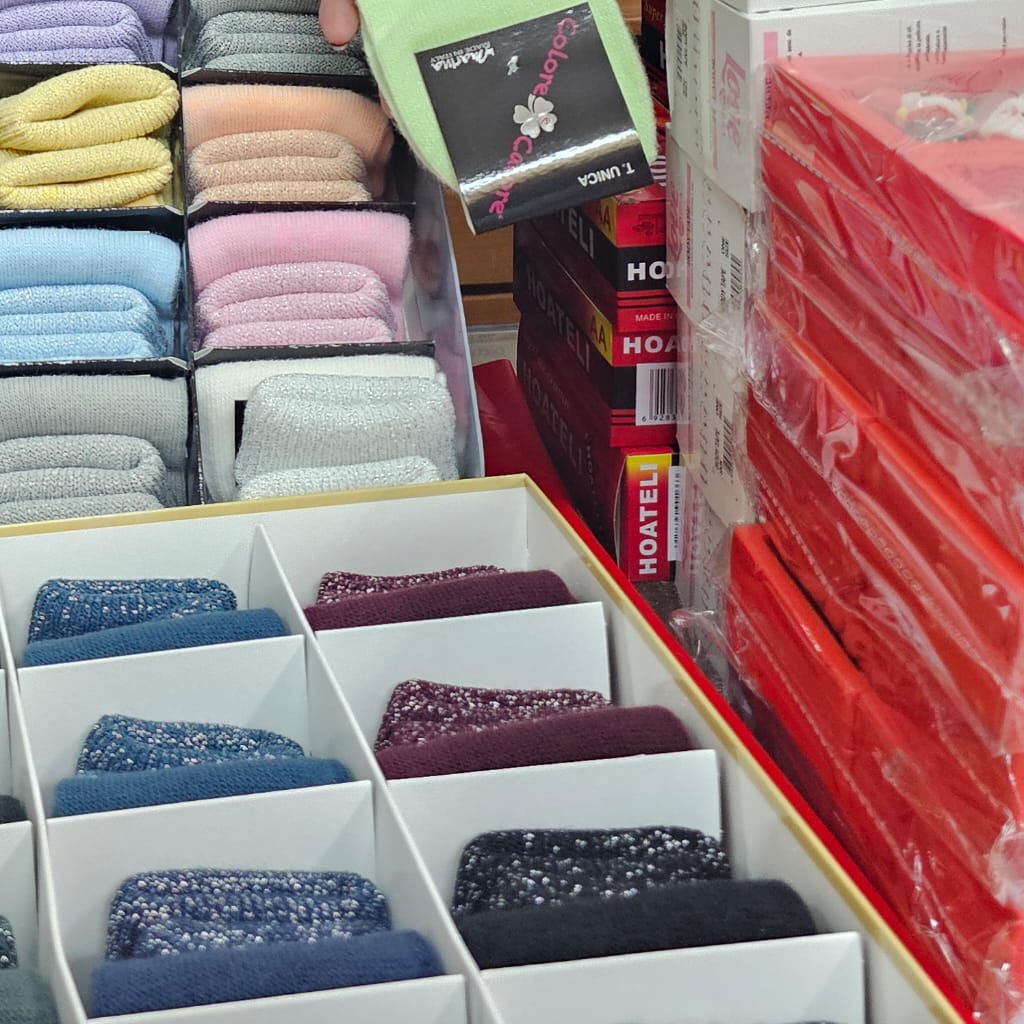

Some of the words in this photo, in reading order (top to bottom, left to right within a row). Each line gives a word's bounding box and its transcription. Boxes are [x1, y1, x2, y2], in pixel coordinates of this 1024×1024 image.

[533, 17, 577, 96] Colore
[577, 164, 621, 187] UNICA
[635, 312, 661, 322] MADE
[638, 463, 658, 575] HOATELI
